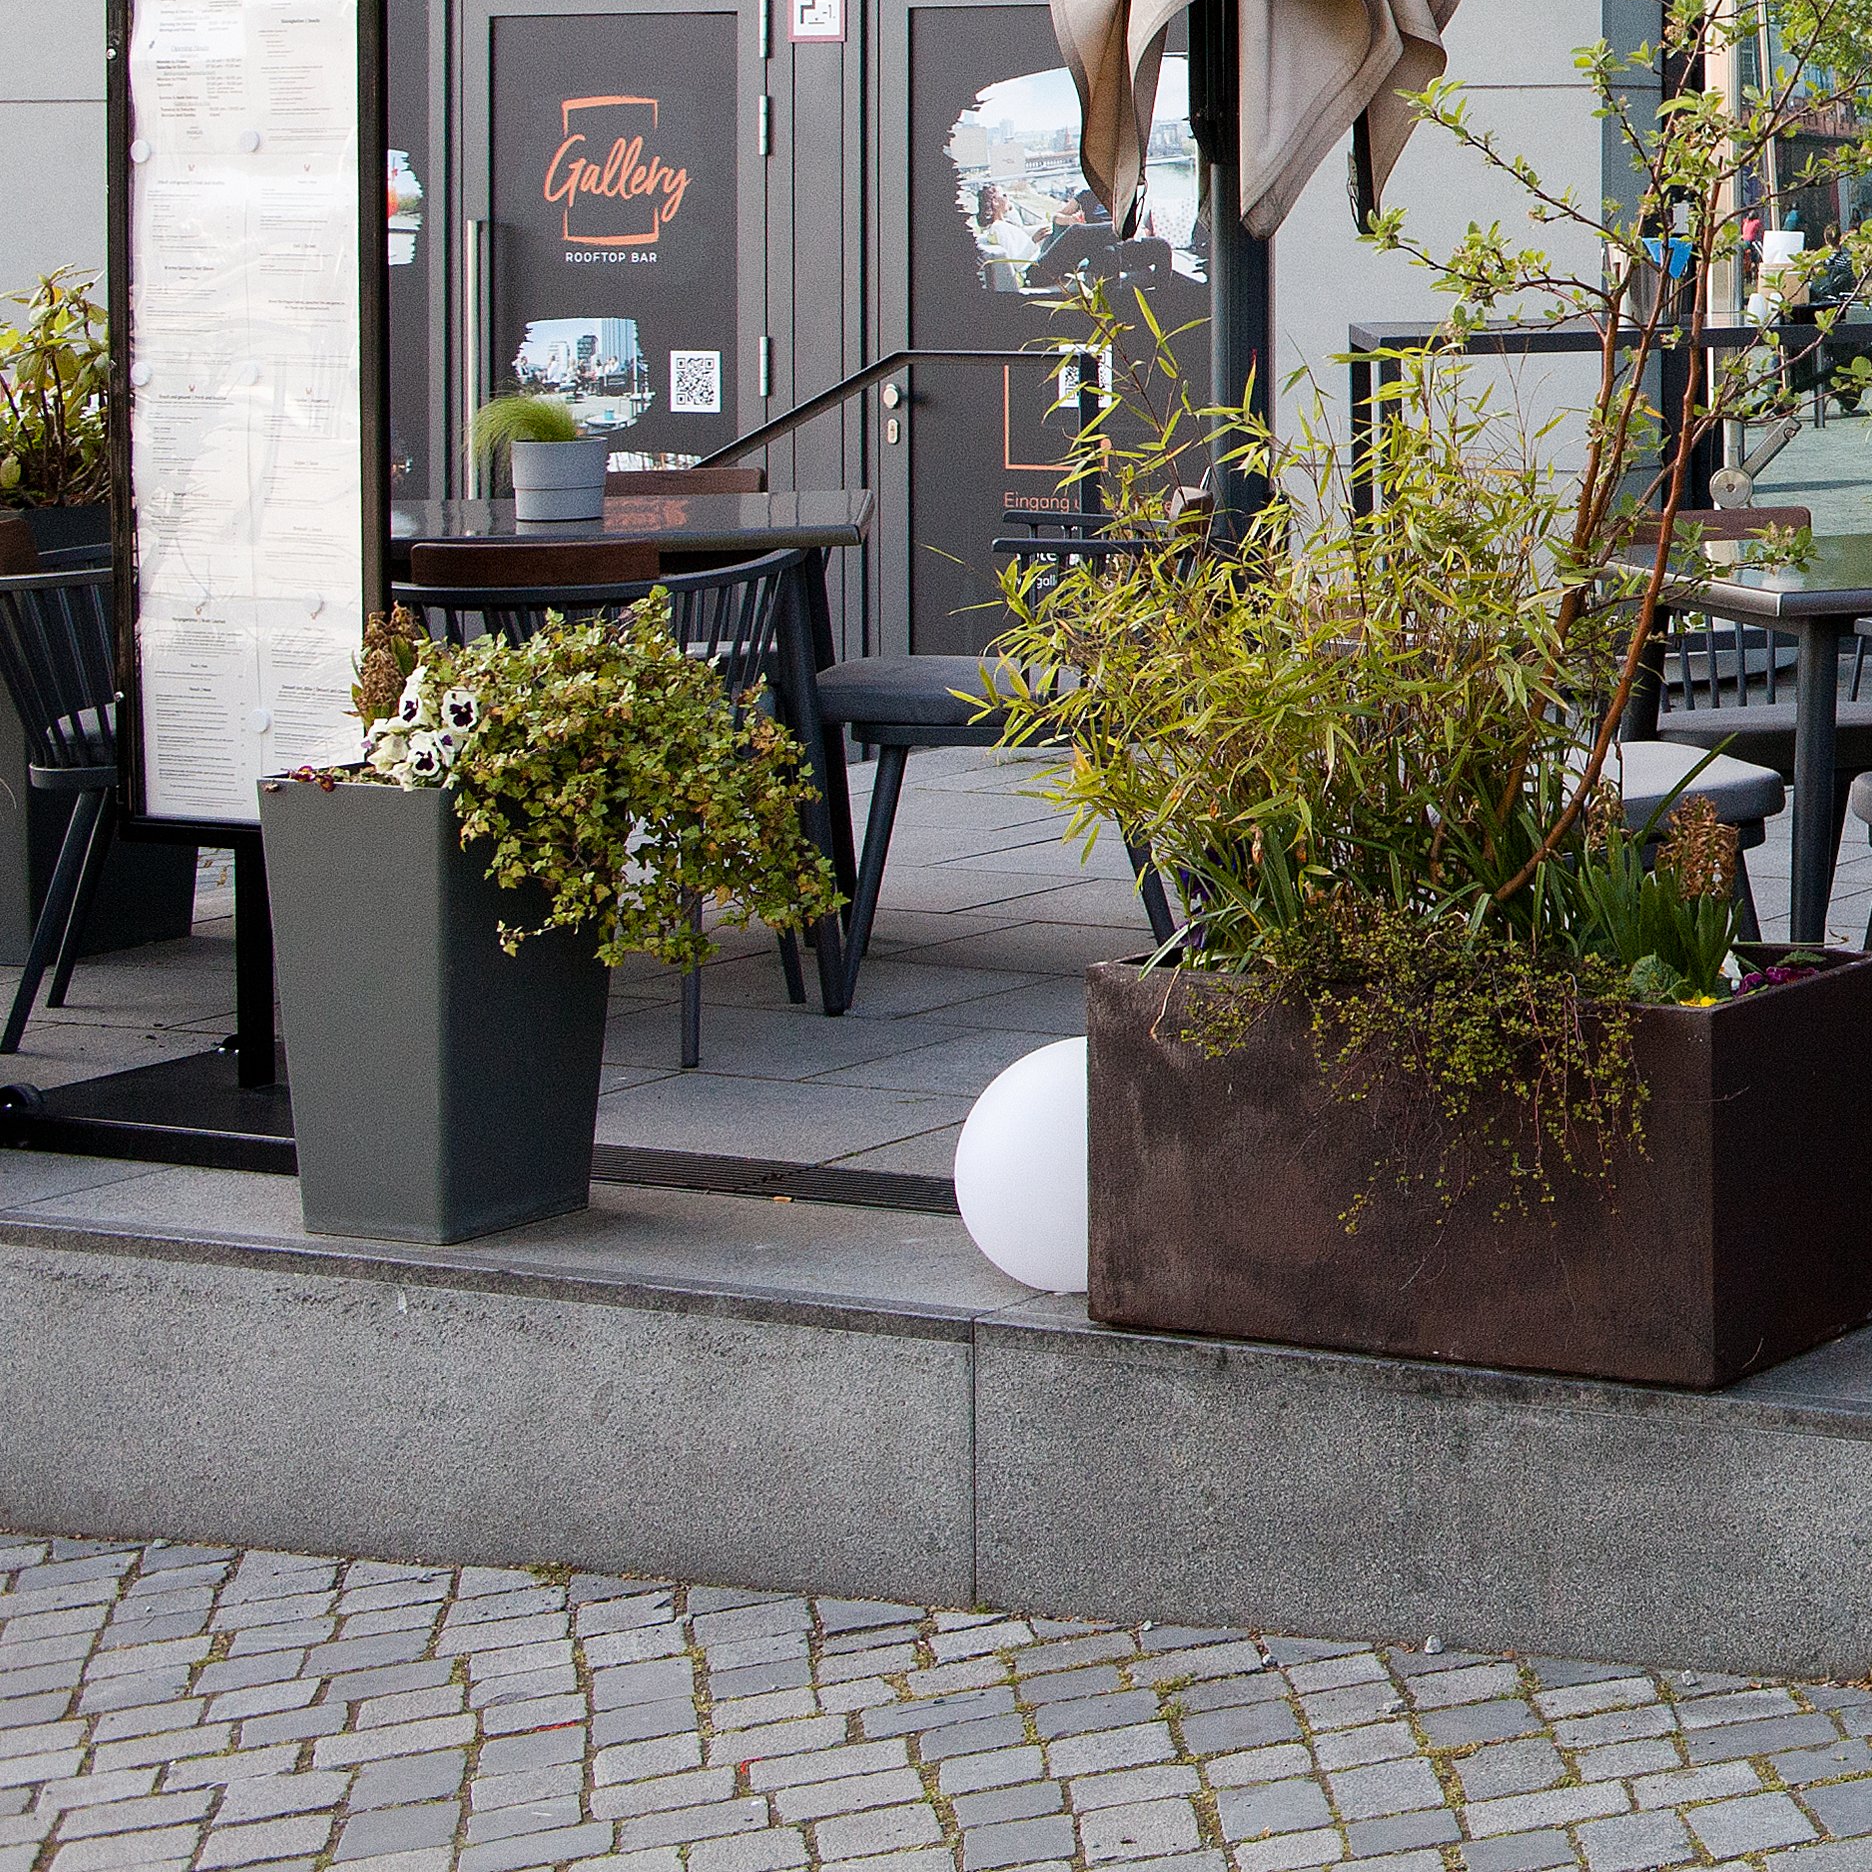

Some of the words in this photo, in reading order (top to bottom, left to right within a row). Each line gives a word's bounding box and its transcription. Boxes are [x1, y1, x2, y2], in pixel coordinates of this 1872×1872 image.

[544, 133, 691, 223] Gallery
[565, 250, 624, 264] ROOFTOP
[630, 250, 658, 263] BAR
[1004, 490, 1070, 513] Eingang
